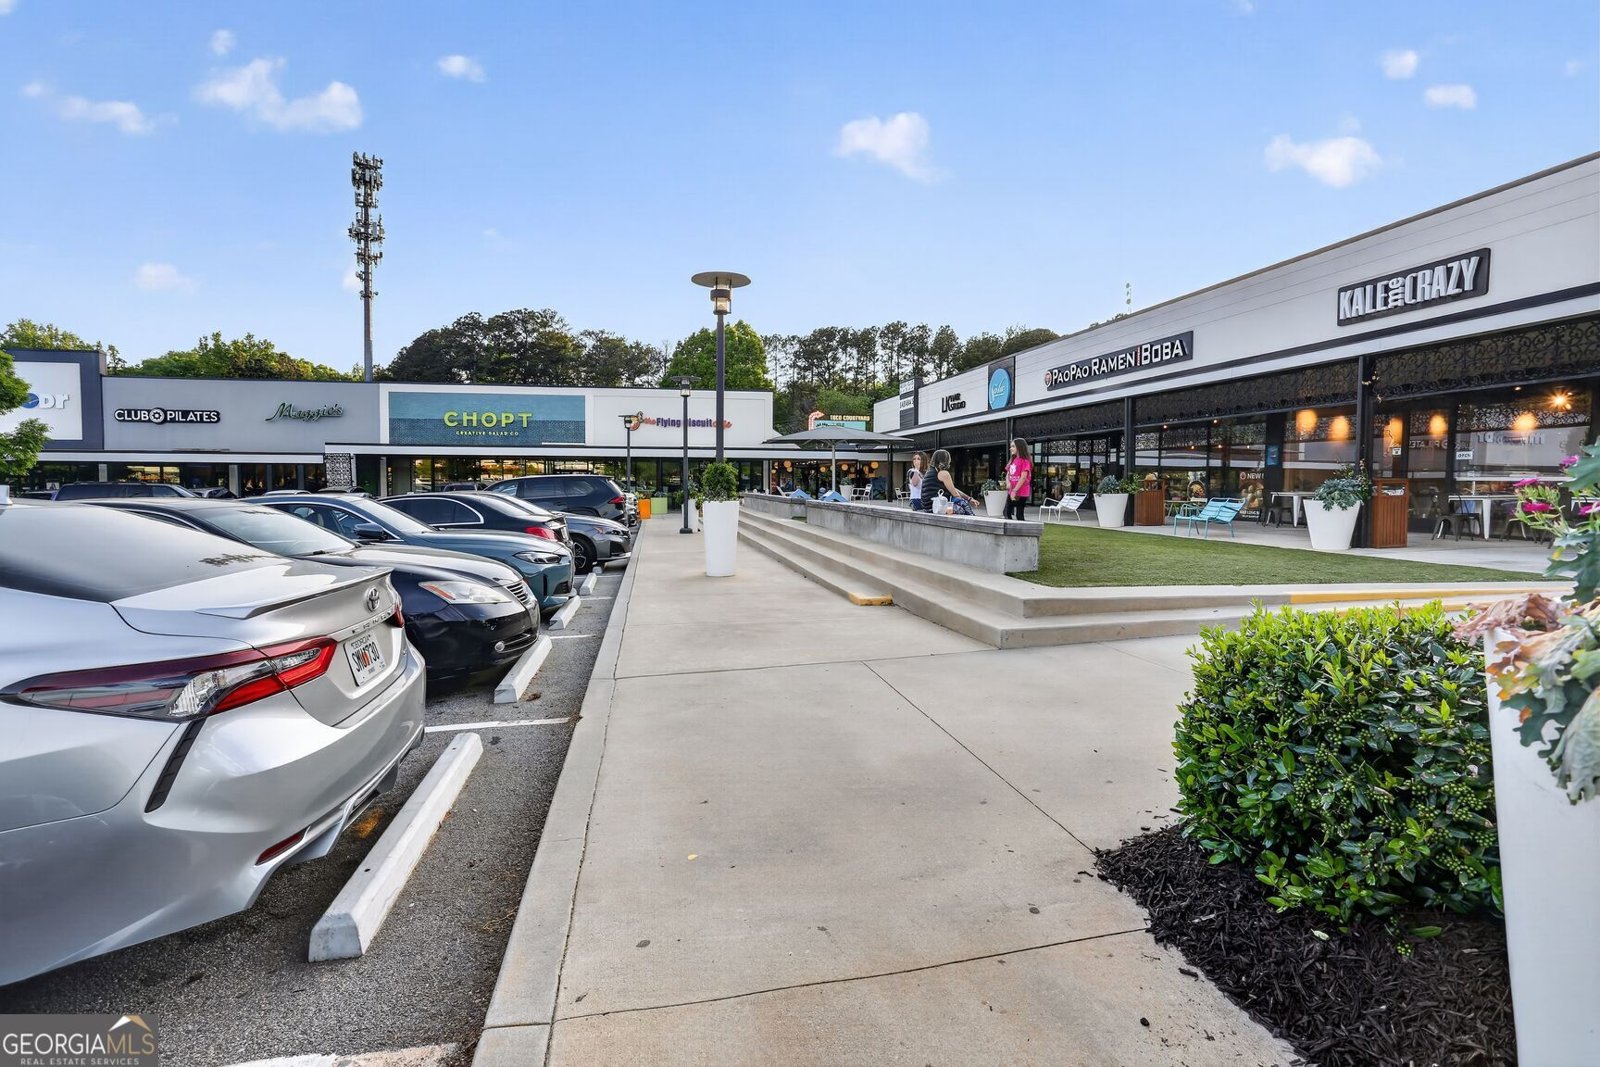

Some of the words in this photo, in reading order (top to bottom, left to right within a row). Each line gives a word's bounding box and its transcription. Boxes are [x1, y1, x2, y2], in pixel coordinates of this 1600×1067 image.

[1340, 280, 1389, 320] KALE
[1388, 277, 1405, 308] me
[1405, 256, 1480, 304] CRAZY
[114, 410, 149, 421] CLUB
[166, 411, 218, 423] PILATES
[265, 402, 344, 422] Maggie's
[443, 411, 532, 428] CHOPT
[656, 417, 681, 428] Flying
[684, 418, 713, 428] iscuit
